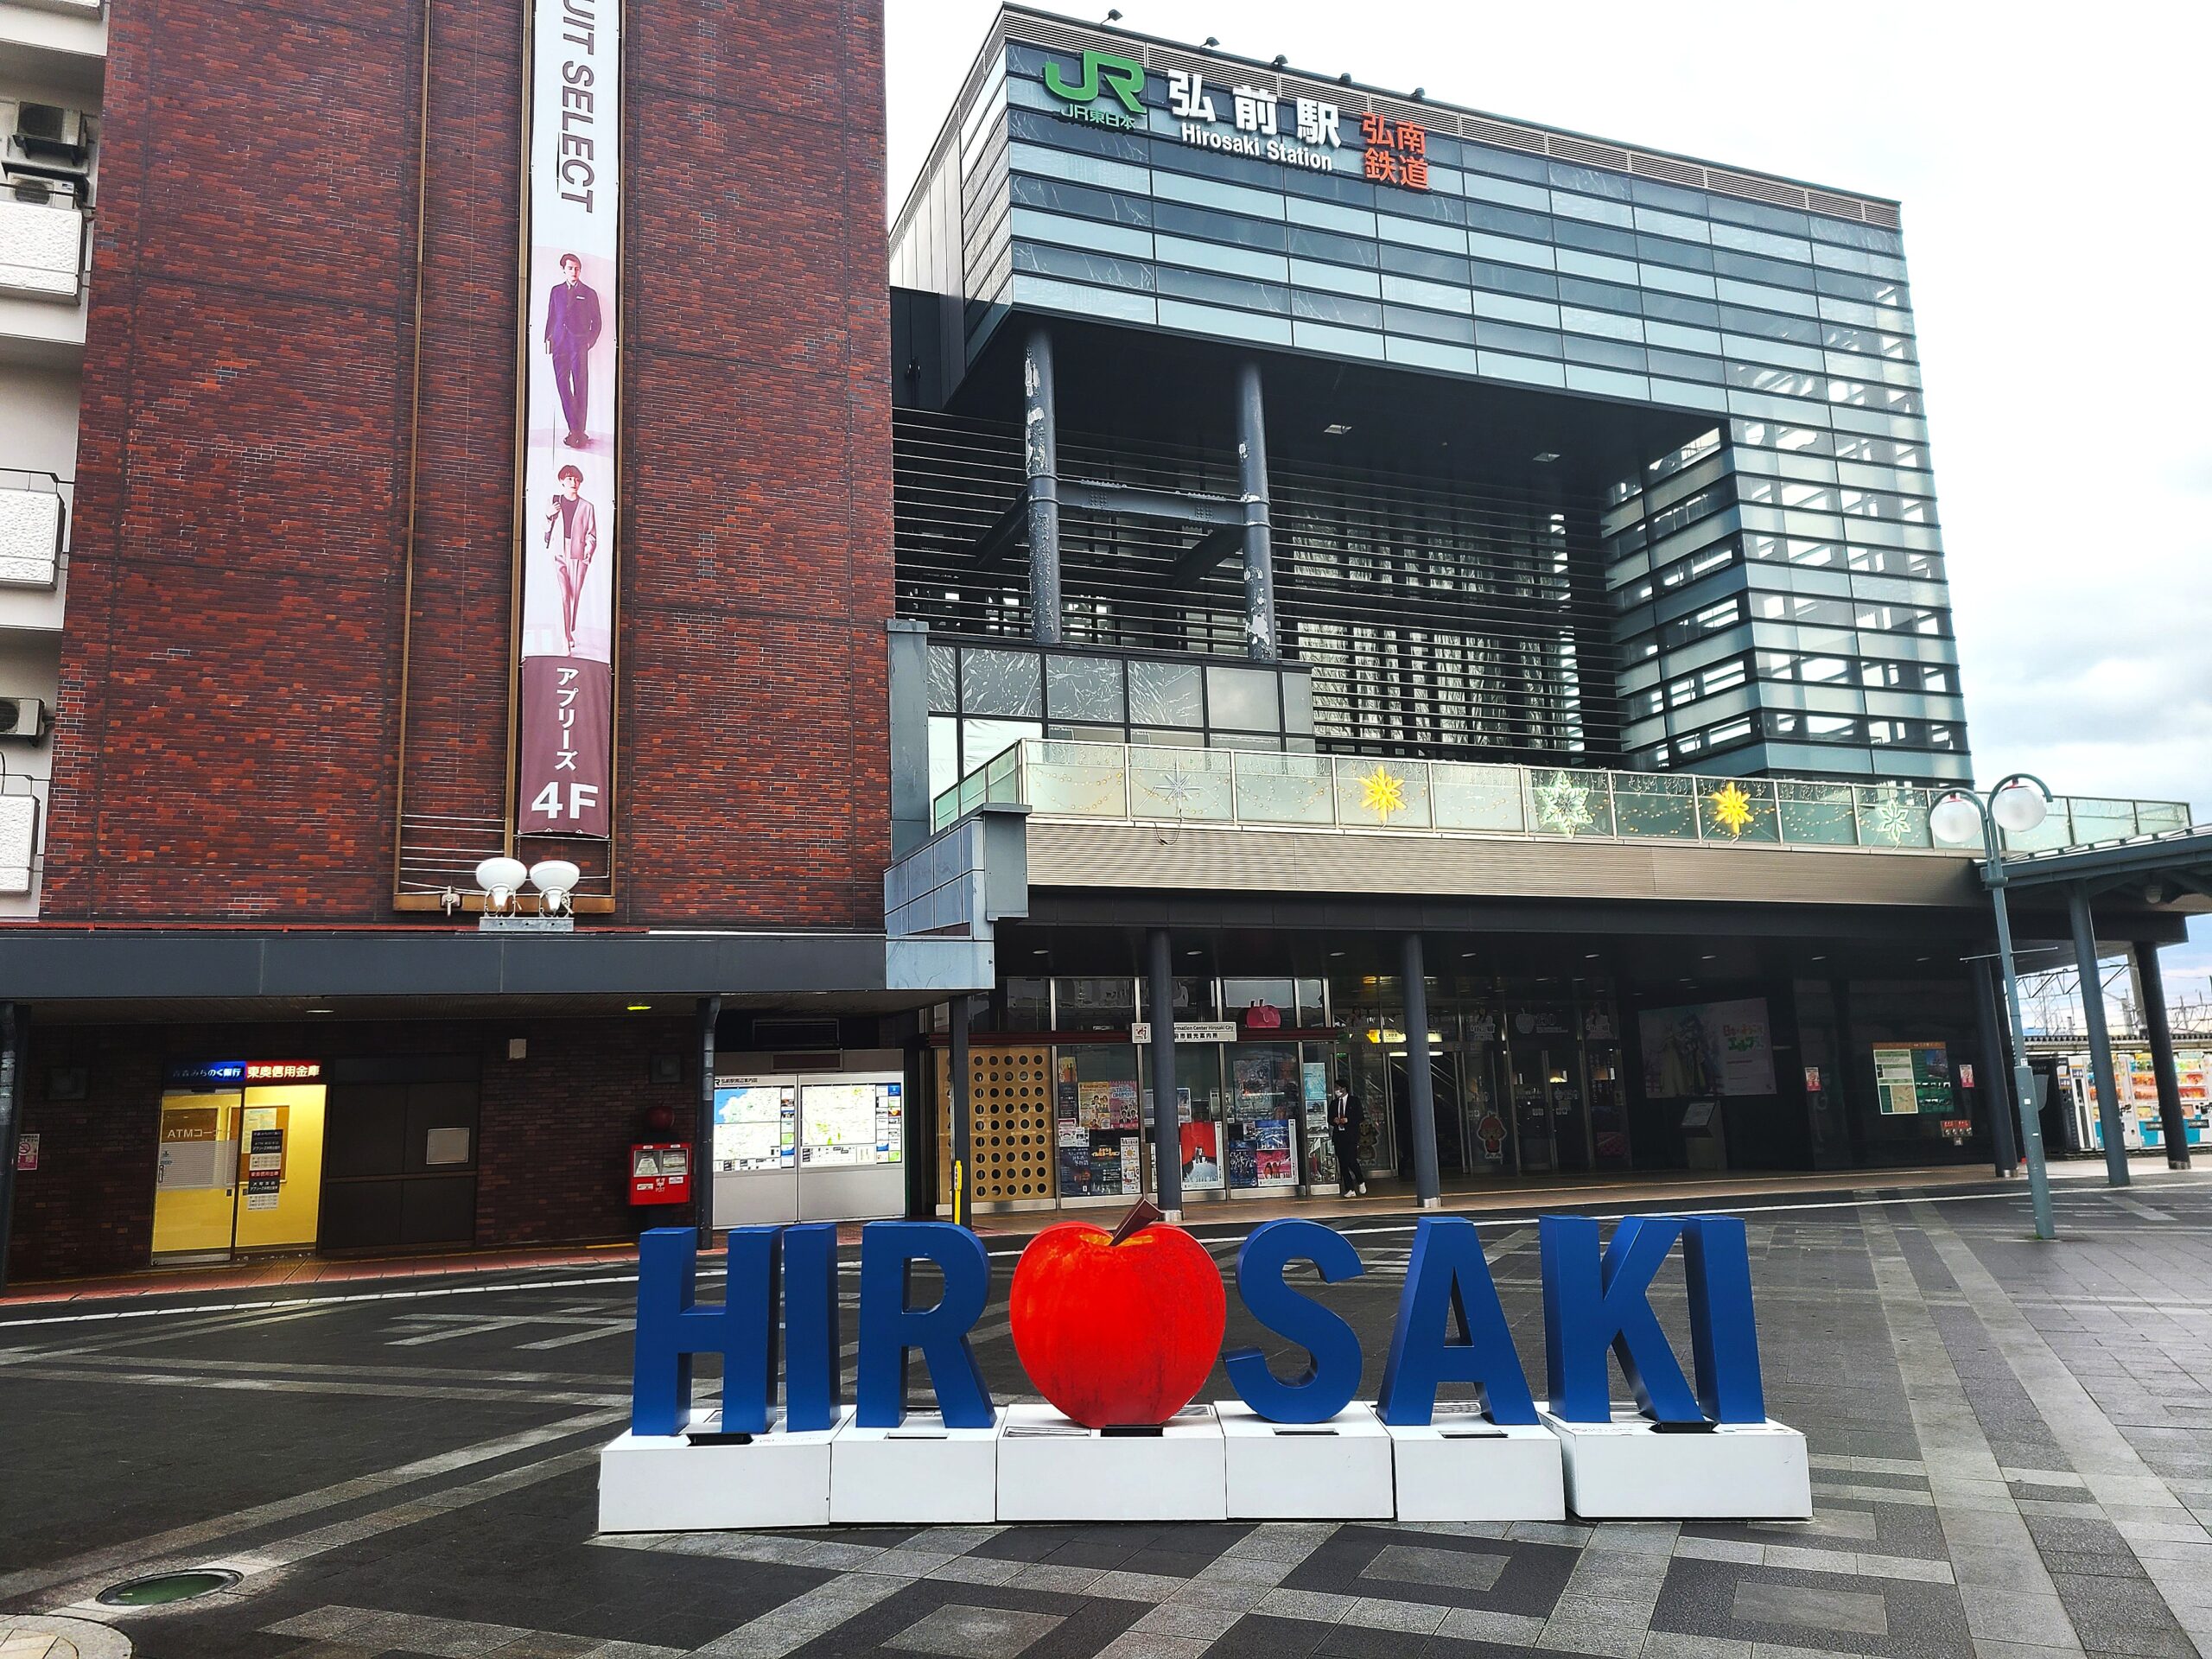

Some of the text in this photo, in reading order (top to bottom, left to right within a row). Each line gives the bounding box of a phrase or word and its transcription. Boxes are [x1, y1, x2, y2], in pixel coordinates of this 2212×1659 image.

[1043, 50, 1147, 114] JR
[562, 0, 594, 213] UIT SELECT
[1060, 103, 1136, 130] JR東日本
[1167, 68, 1342, 149] 弘前駅
[1182, 123, 1332, 171] Hirosaki Station
[1361, 112, 1426, 156] 弘南
[1363, 149, 1429, 189] 鉄道
[555, 668, 580, 771] アプリーズ
[531, 782, 599, 819] 4F
[247, 1065, 320, 1078] 東奥信用金庫
